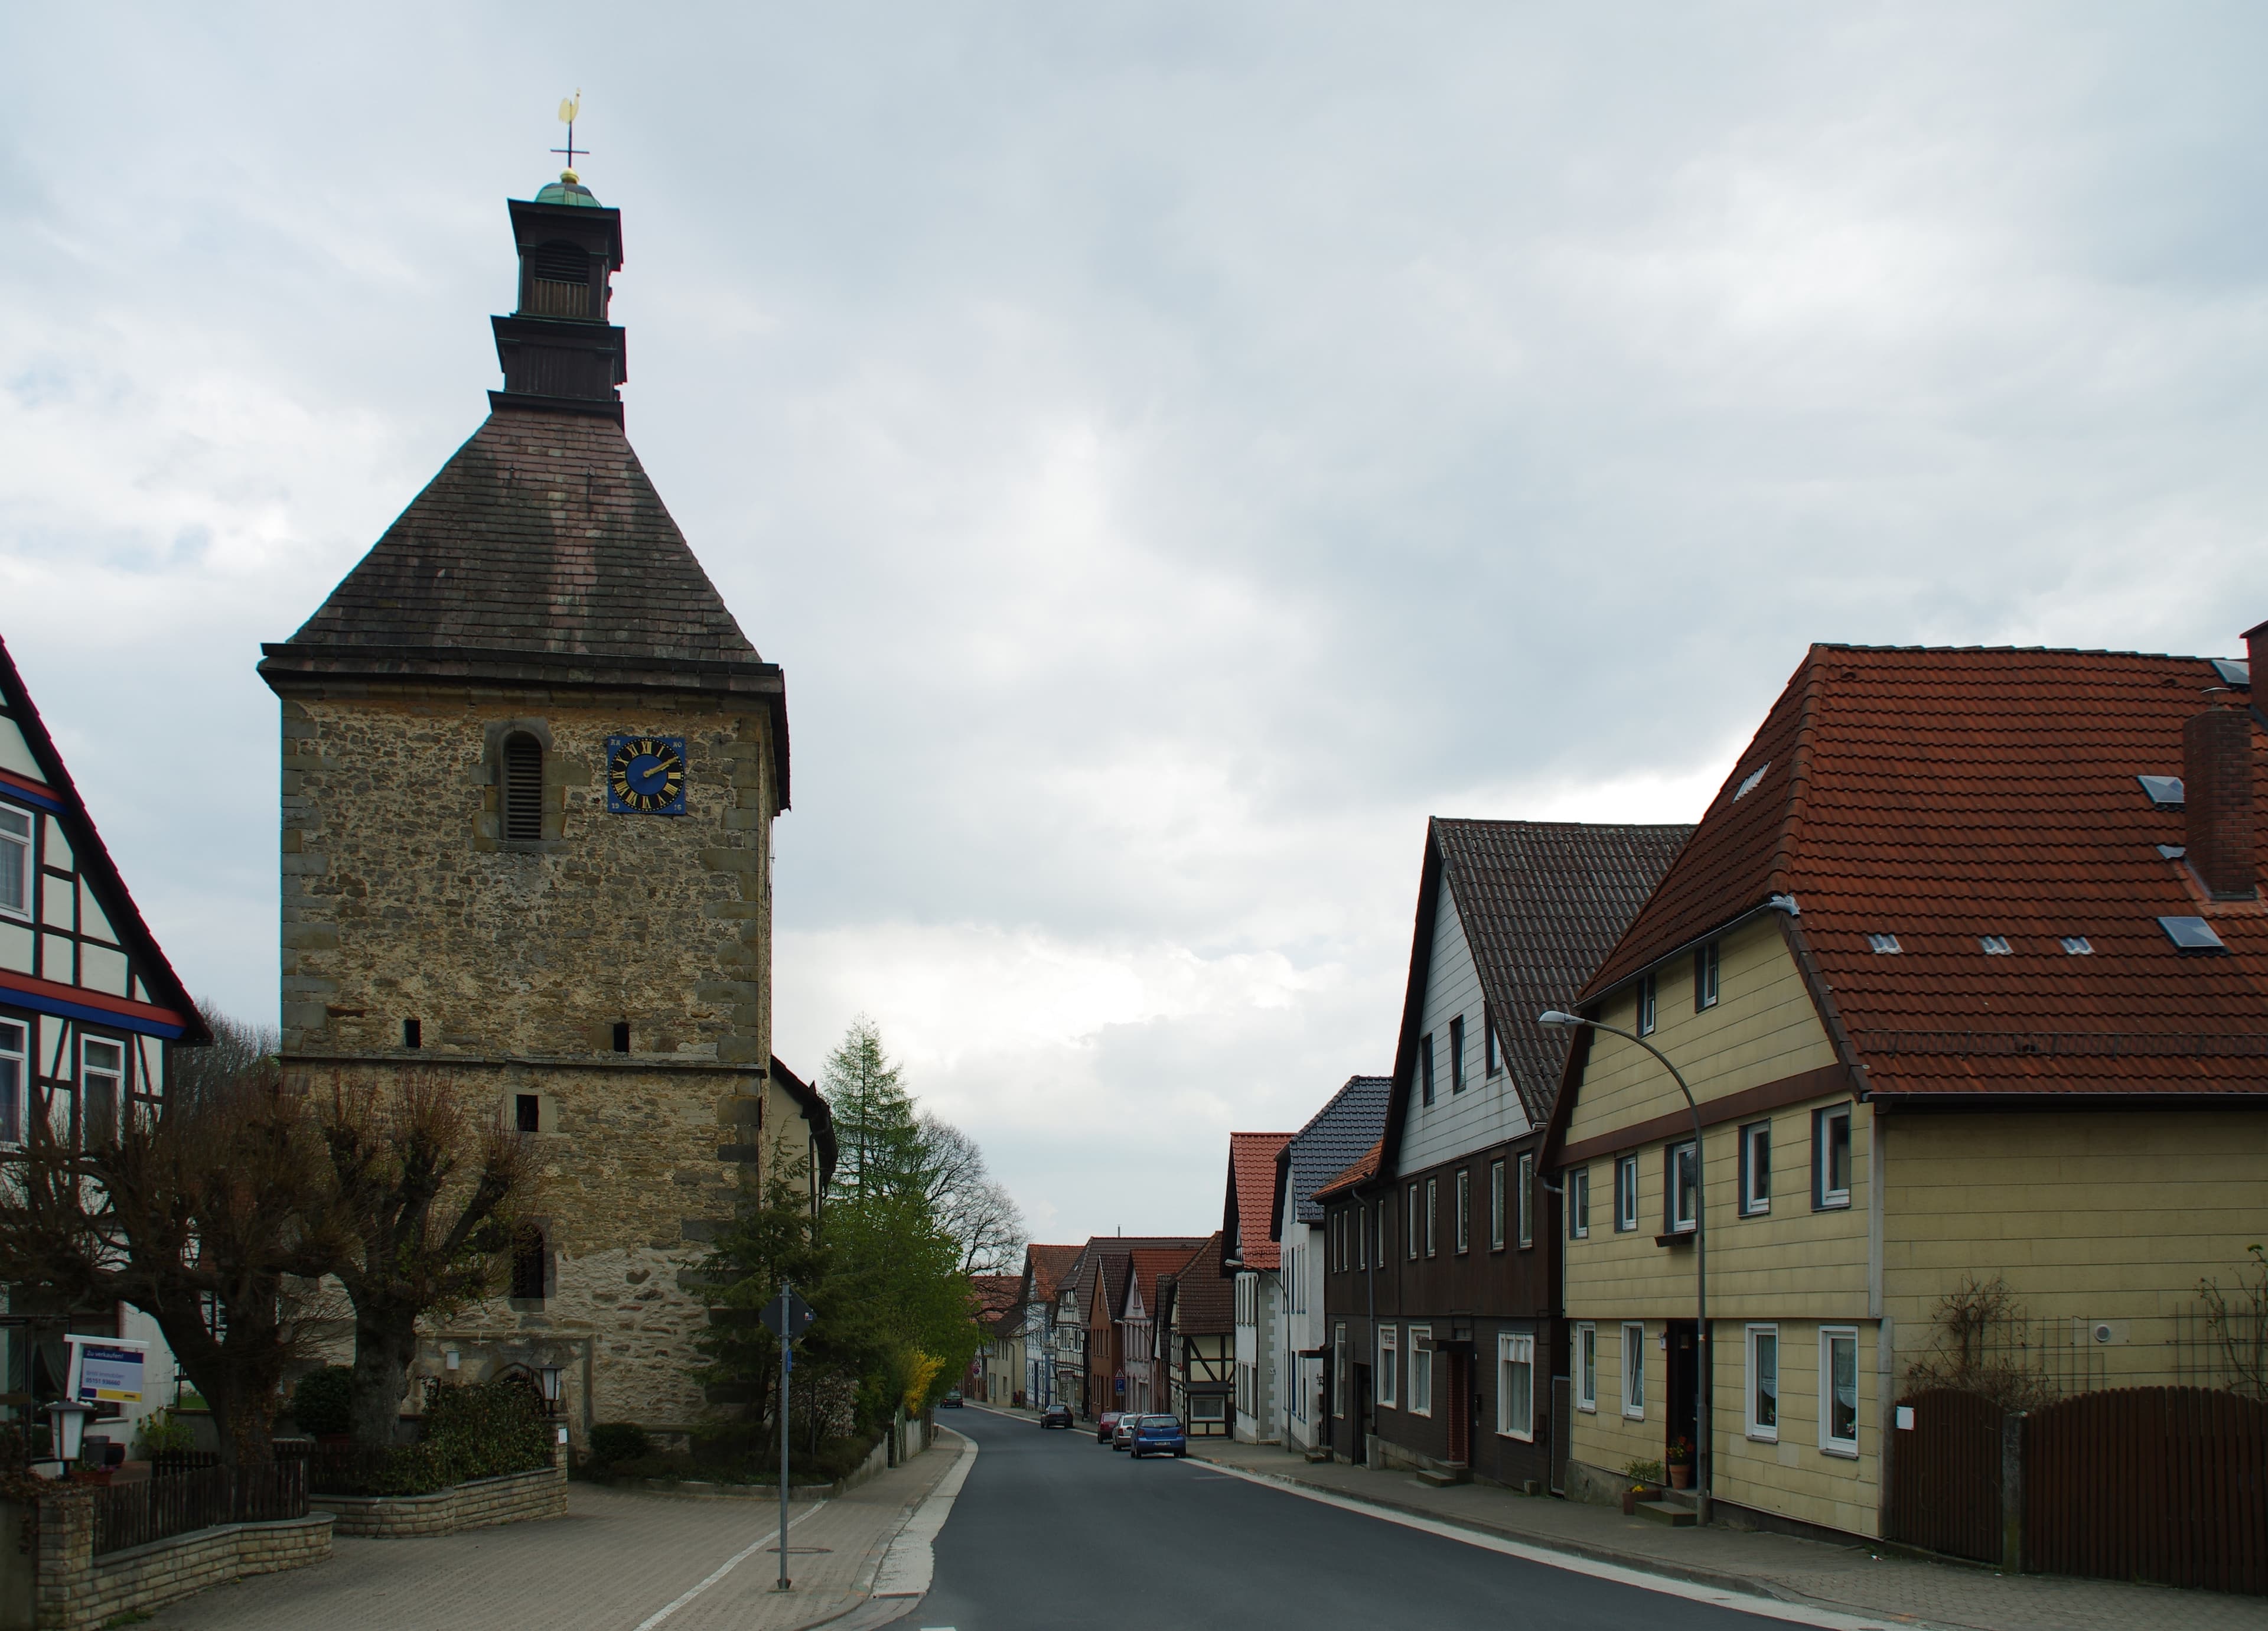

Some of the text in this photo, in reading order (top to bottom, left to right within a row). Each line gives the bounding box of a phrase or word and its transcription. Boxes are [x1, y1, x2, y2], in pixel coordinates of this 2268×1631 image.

[626, 743, 639, 758] XI
[641, 741, 652, 754] XII
[656, 745, 666, 757] I
[615, 755, 630, 767] X
[612, 770, 625, 779] IX
[614, 780, 629, 796] VIII
[625, 790, 638, 806] VII
[641, 796, 652, 809] VI
[657, 793, 666, 806] V
[94, 1351, 123, 1359] verkaufen!
